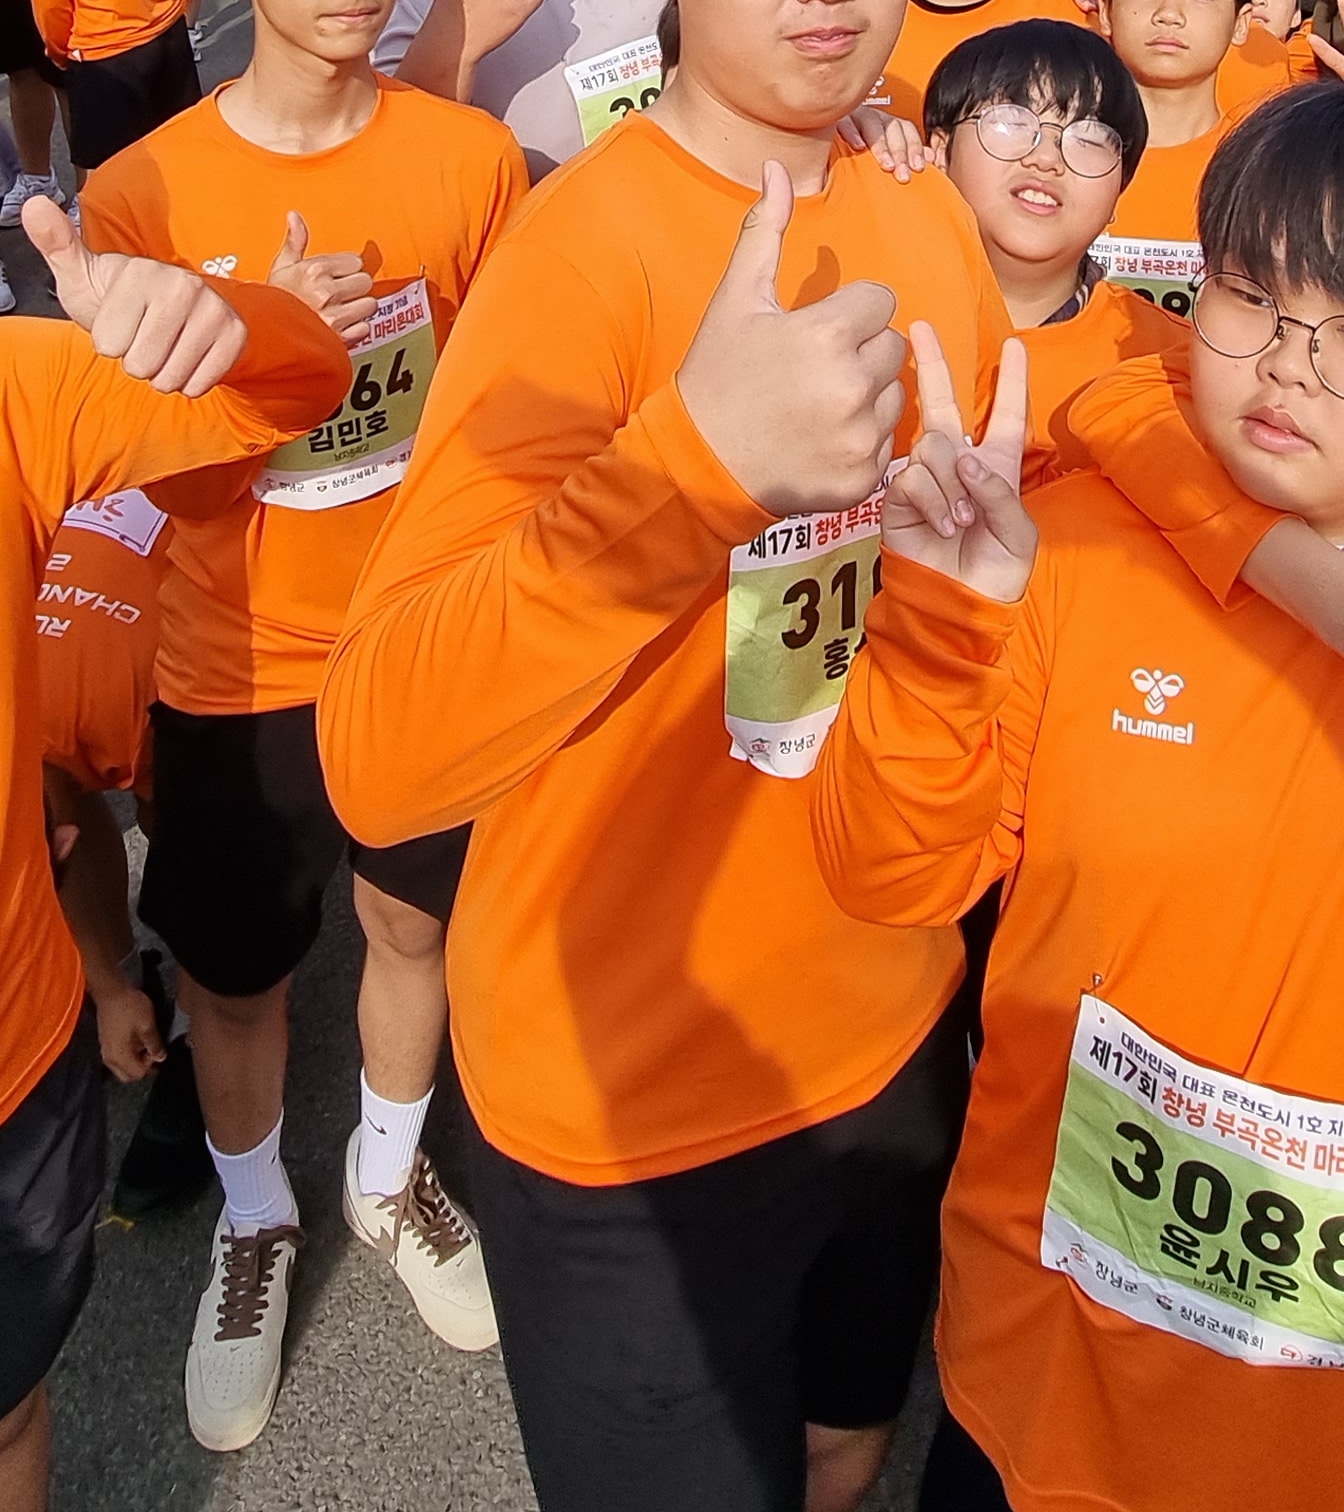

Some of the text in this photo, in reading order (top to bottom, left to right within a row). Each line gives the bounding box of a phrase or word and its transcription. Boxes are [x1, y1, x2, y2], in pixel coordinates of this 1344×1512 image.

[580, 68, 619, 90] 제17회
[336, 347, 414, 416] 64
[308, 409, 389, 454] 김민호
[748, 522, 811, 559] 제17회
[815, 515, 842, 546] 창녕
[781, 554, 882, 650] 31
[1112, 708, 1194, 745] hummel
[1089, 1035, 1158, 1104] 제17회
[1162, 1086, 1207, 1128] 창녕
[1212, 1108, 1308, 1171] 부곡온천
[1121, 1032, 1178, 1084] 대한민국
[1182, 1074, 1217, 1099] 대표
[1222, 1089, 1291, 1127] 온천도시
[1297, 1114, 1322, 1135] 1호
[1160, 1223, 1299, 1303] 윤시우
[1095, 1260, 1140, 1295] 창녕군
[1179, 1305, 1264, 1351] 창녕군체육회
